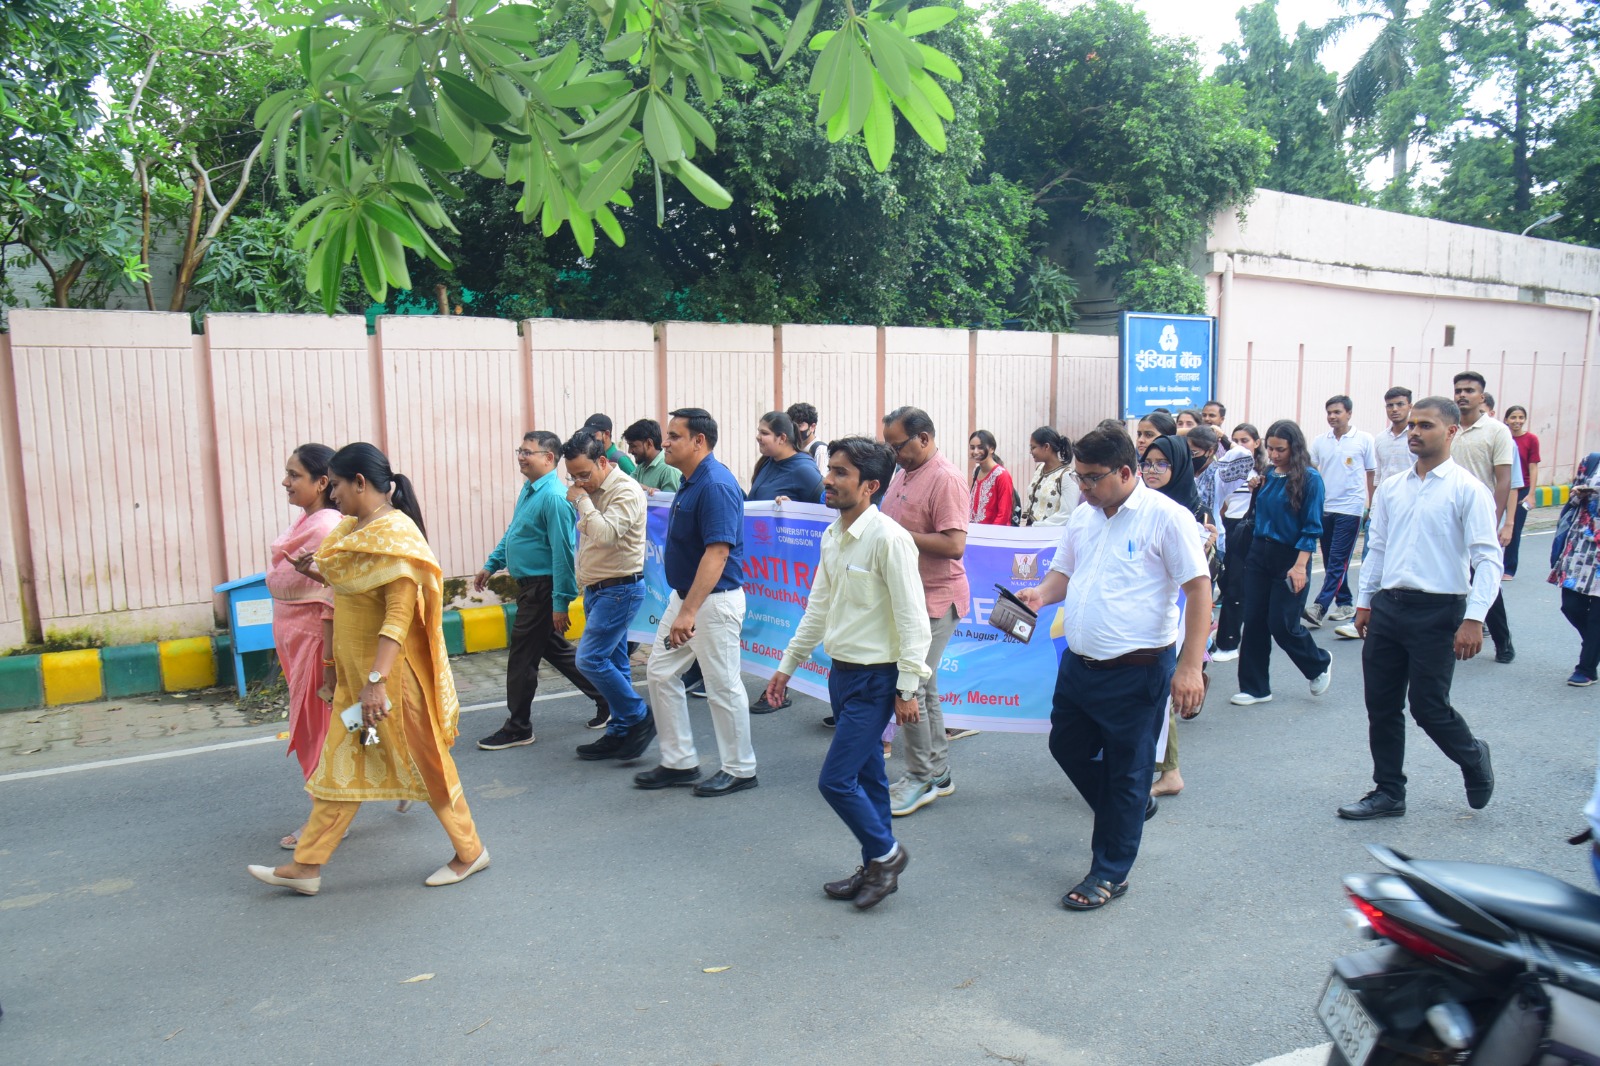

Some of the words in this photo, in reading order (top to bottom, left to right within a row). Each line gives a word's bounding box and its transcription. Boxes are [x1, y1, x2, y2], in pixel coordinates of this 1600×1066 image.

[1135, 350, 1177, 371] इंडियन
[1180, 352, 1202, 368] बैंक
[776, 526, 809, 537] UNIVERSITY
[778, 535, 814, 547] COMMISSION
[742, 556, 789, 585] ANTI
[748, 610, 790, 628] Awarness
[966, 630, 998, 641] August
[752, 642, 784, 661] BOARD
[967, 691, 1019, 706] Meerut
